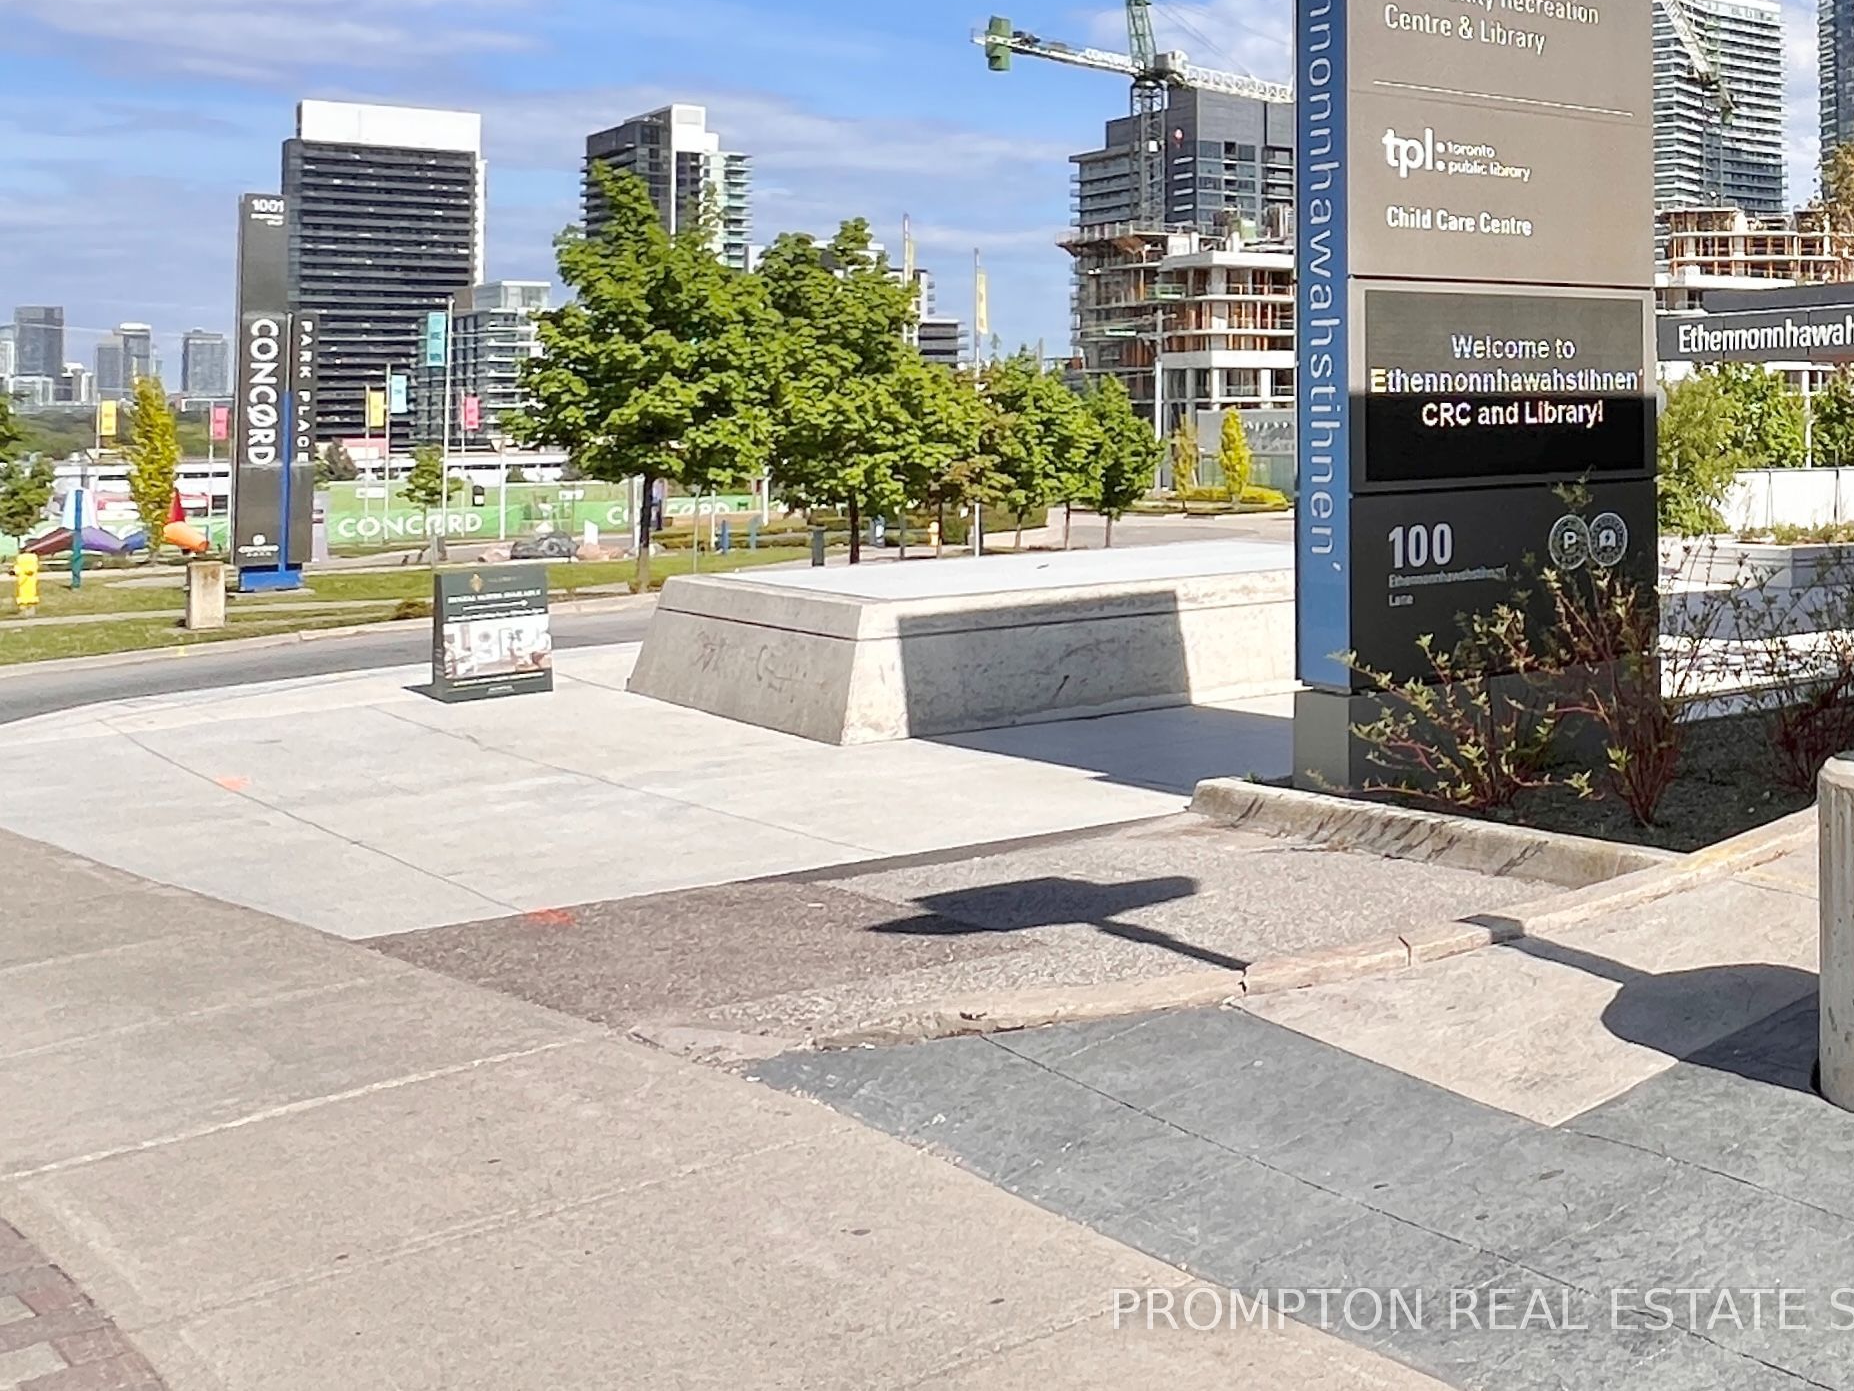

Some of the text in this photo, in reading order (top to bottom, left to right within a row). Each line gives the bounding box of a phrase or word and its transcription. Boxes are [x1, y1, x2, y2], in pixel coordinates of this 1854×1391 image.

[1384, 4, 1546, 56] Centre & Library
[1446, 141, 1496, 159] toronto
[1448, 159, 1532, 183] public library
[1386, 206, 1533, 237] Child Care Centre
[1451, 334, 1576, 359] Welcome to
[297, 320, 313, 463] PARK PLACE
[1421, 402, 1471, 427] CRC
[1477, 402, 1519, 425] and
[1388, 523, 1452, 568] 100
